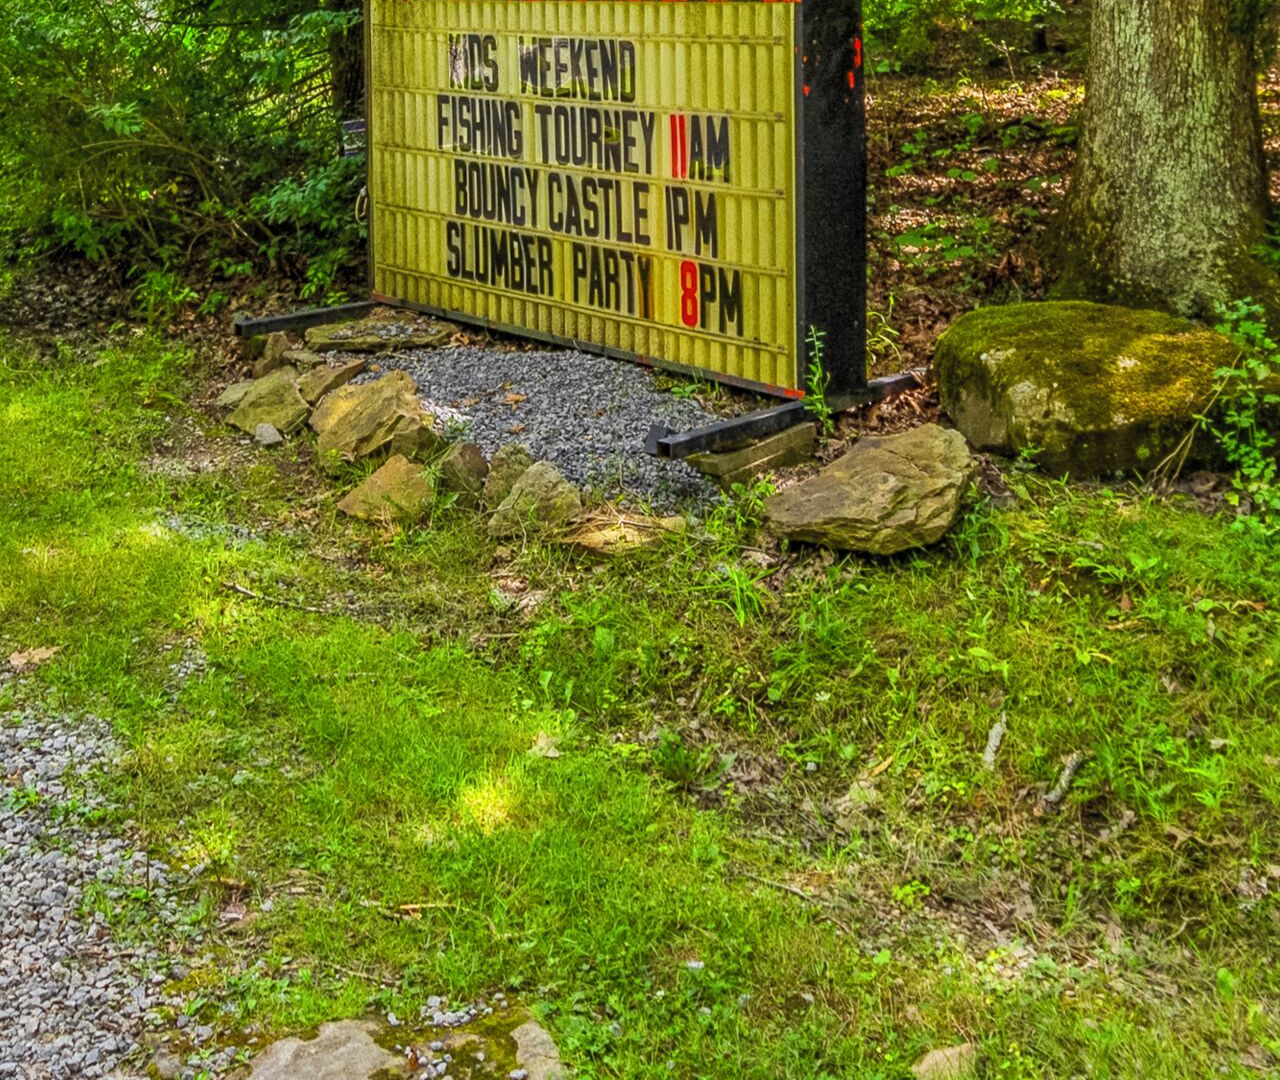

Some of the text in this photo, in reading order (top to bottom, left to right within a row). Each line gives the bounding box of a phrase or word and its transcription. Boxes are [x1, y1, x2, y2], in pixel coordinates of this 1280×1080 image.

[448, 33, 636, 102] KIDS WEEKEND
[437, 94, 730, 183] FISHING TOURNEY 11AM
[455, 159, 539, 228] BOUNCY
[548, 172, 651, 245] CASTLE
[446, 221, 744, 337] SLUMBER PARTY 8PM
